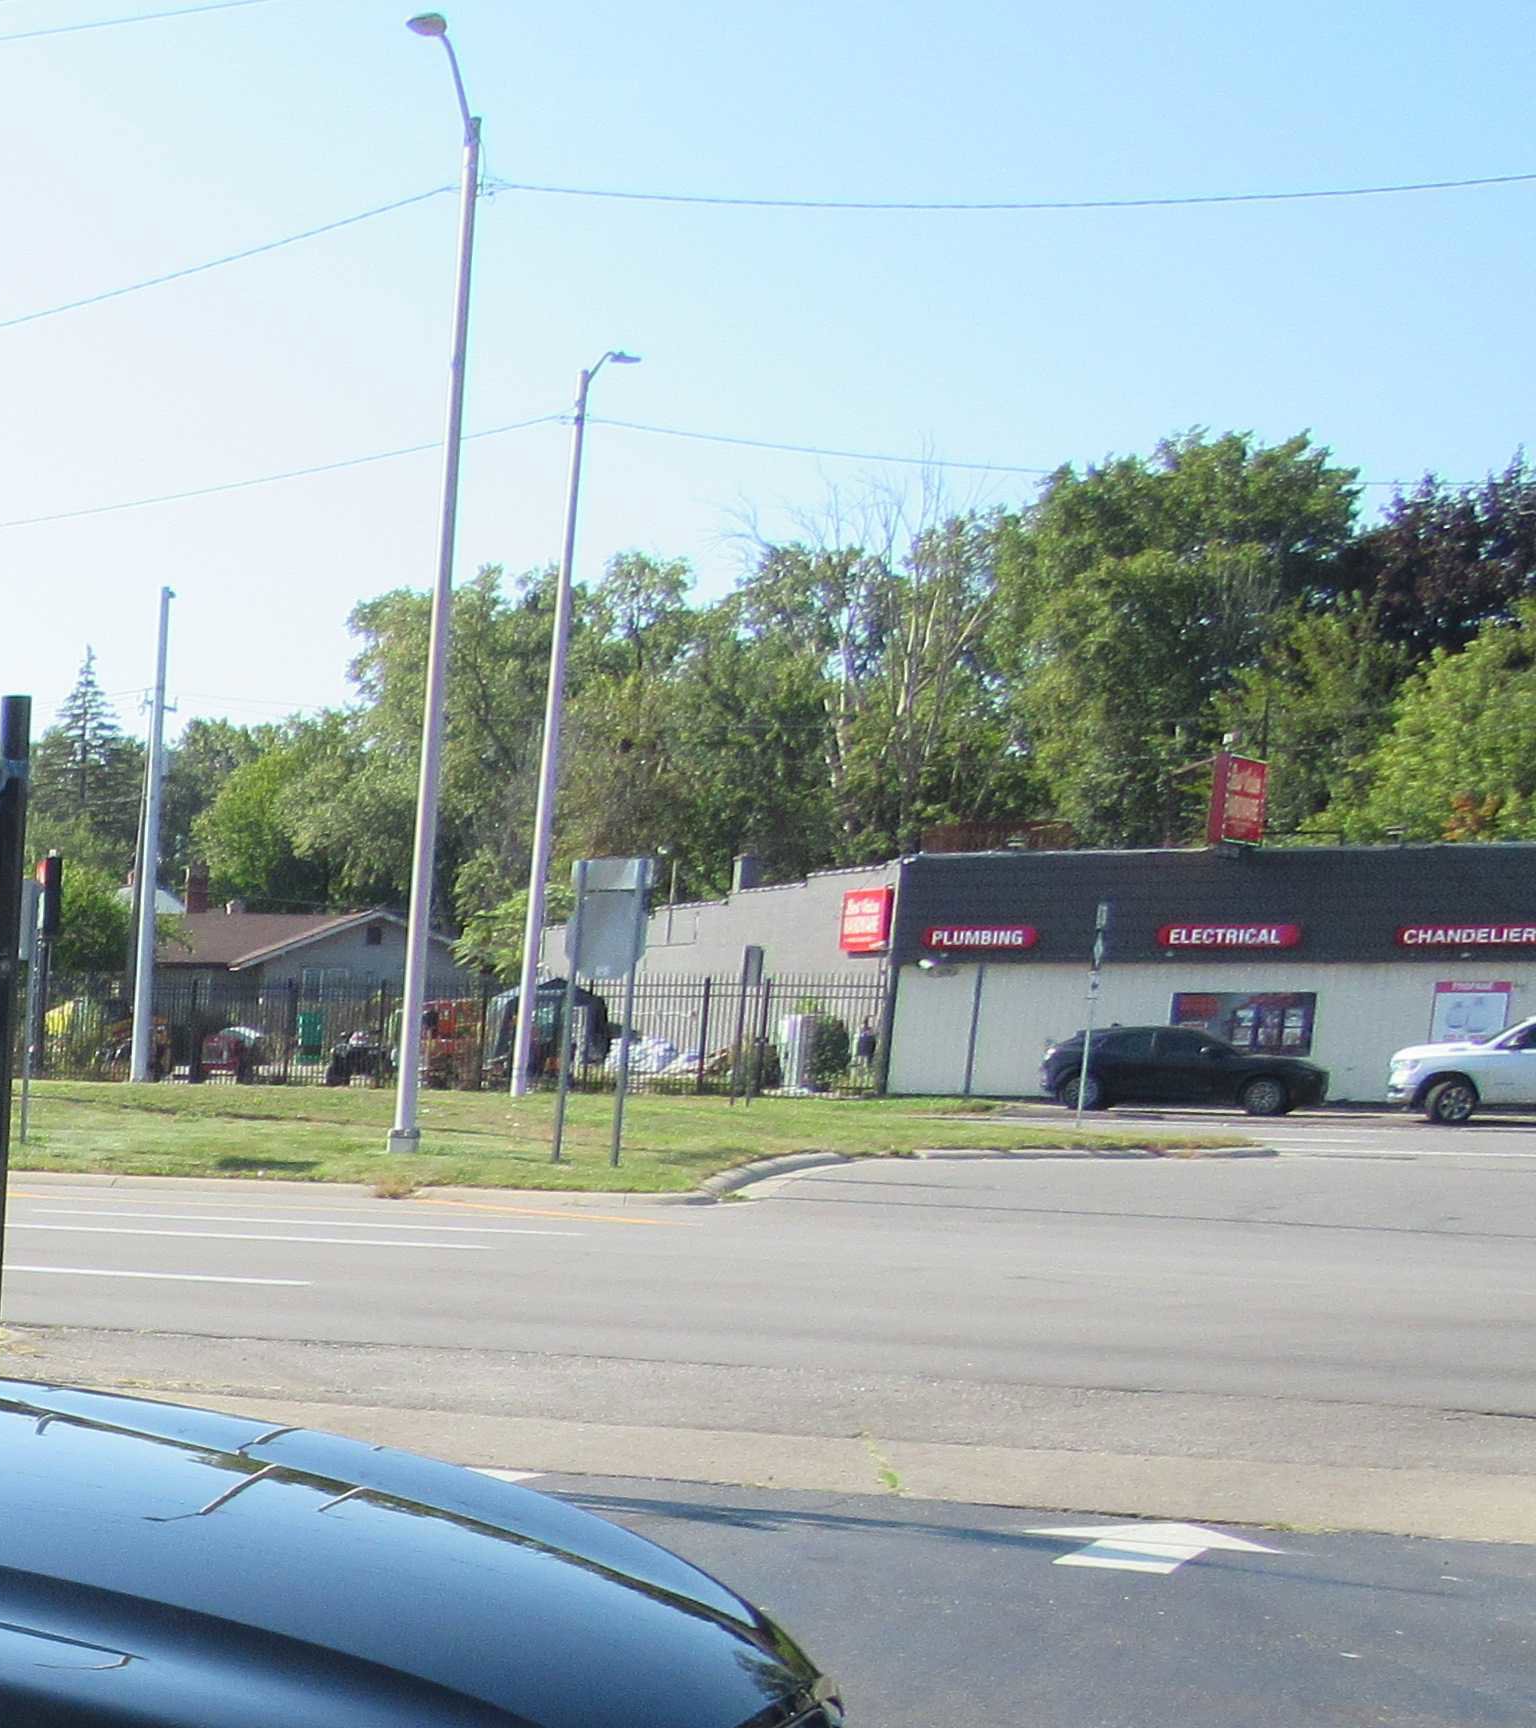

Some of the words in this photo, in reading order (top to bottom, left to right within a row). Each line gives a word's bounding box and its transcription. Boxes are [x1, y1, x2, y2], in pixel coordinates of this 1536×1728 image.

[931, 930, 1023, 945] PLUMBING
[1169, 928, 1280, 944] ELECTRICAL
[1404, 928, 1536, 944] CHANDELIER
